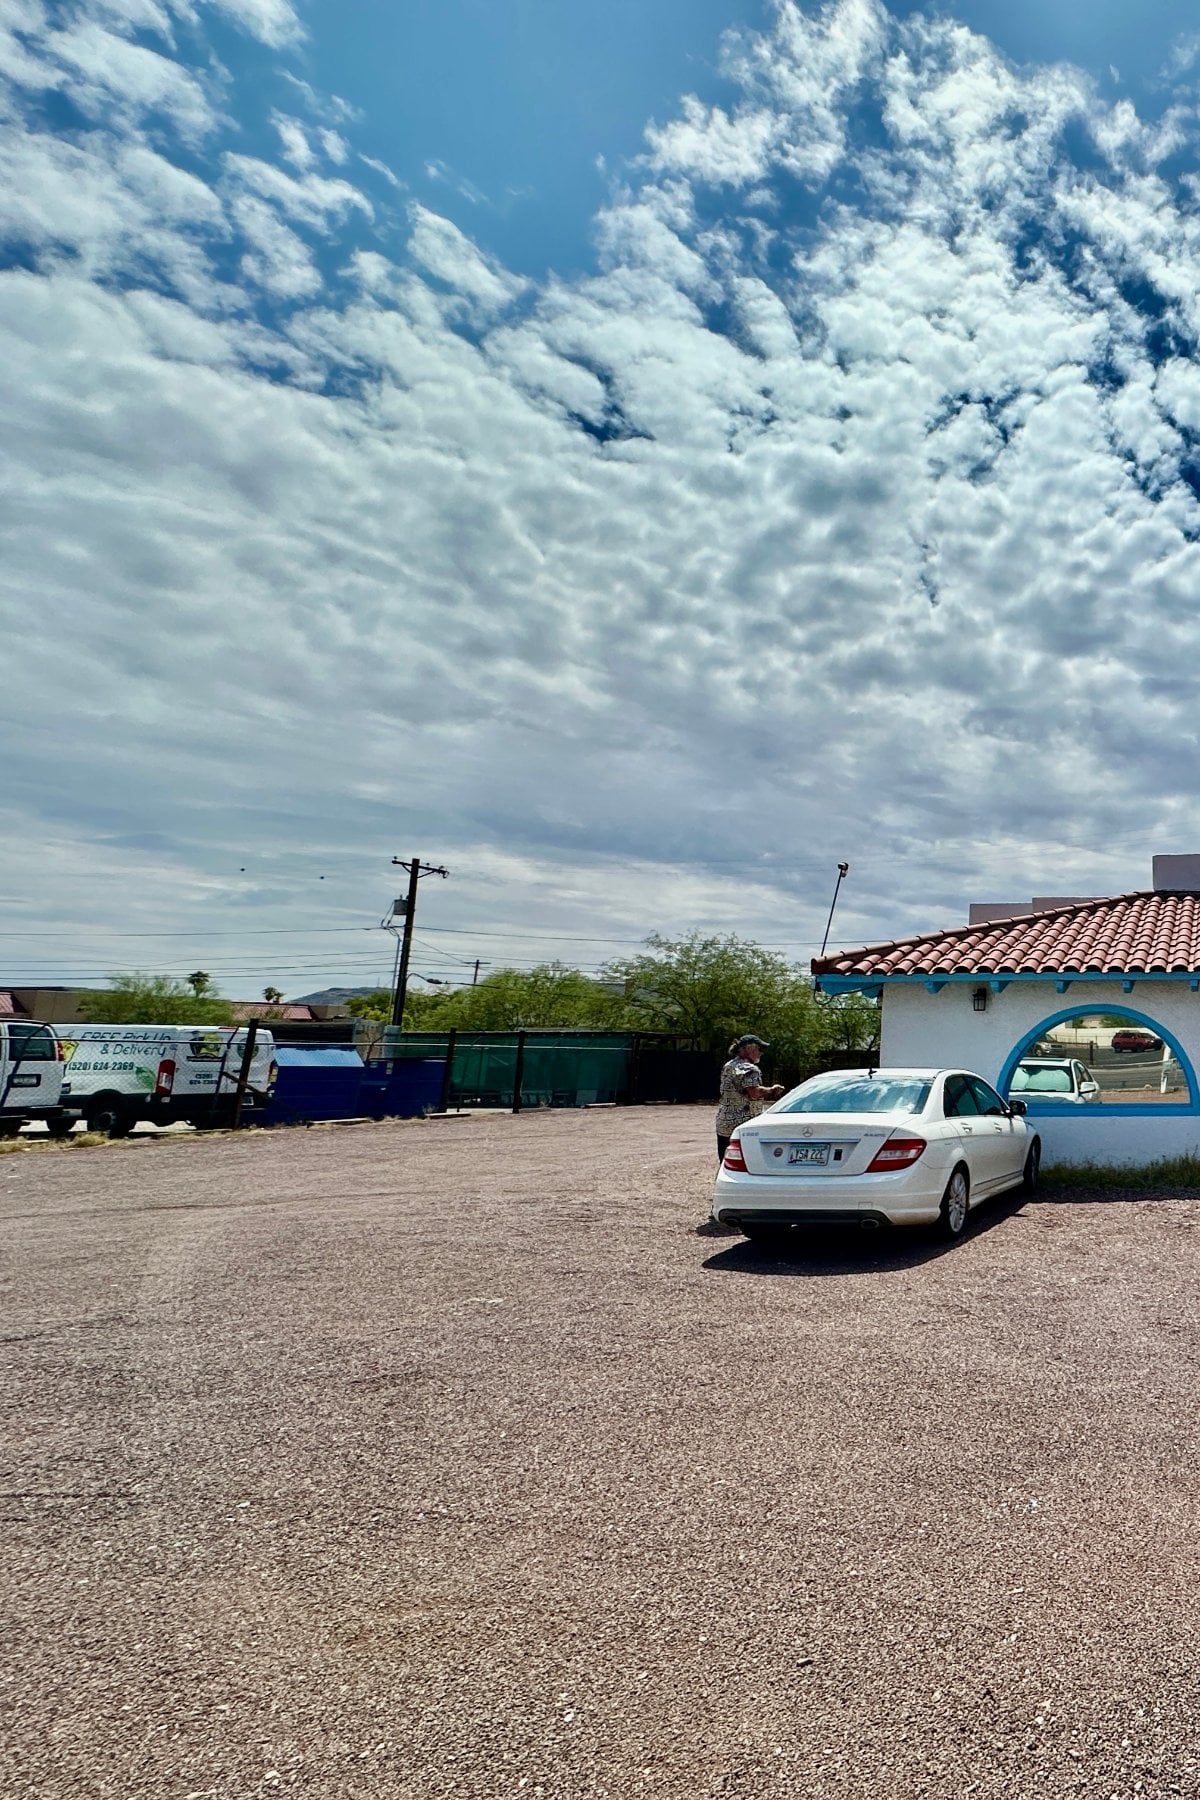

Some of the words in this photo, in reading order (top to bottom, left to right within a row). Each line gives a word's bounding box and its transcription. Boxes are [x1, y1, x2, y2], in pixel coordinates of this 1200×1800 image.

[100, 1043, 109, 1055] &
[112, 1043, 167, 1057] Delivery
[68, 1061, 91, 1071] (520)
